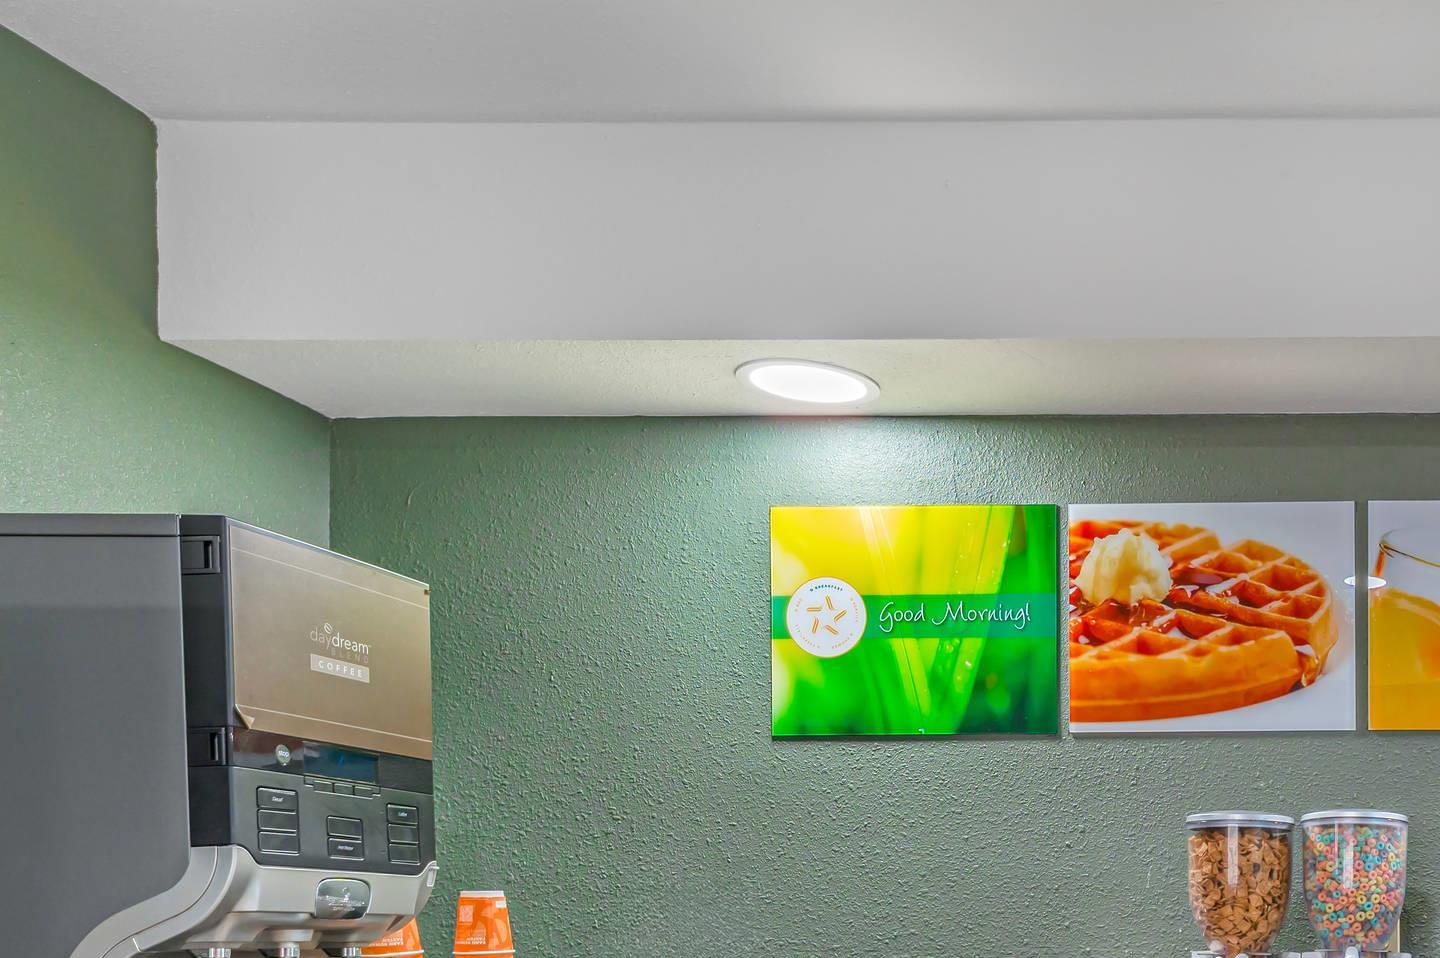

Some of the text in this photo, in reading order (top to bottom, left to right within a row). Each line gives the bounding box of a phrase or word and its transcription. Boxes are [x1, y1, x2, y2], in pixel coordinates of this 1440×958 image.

[879, 601, 926, 633] Good
[931, 600, 1031, 630] Morning!
[309, 626, 369, 655] daydream
[318, 660, 363, 679] COFFEE
